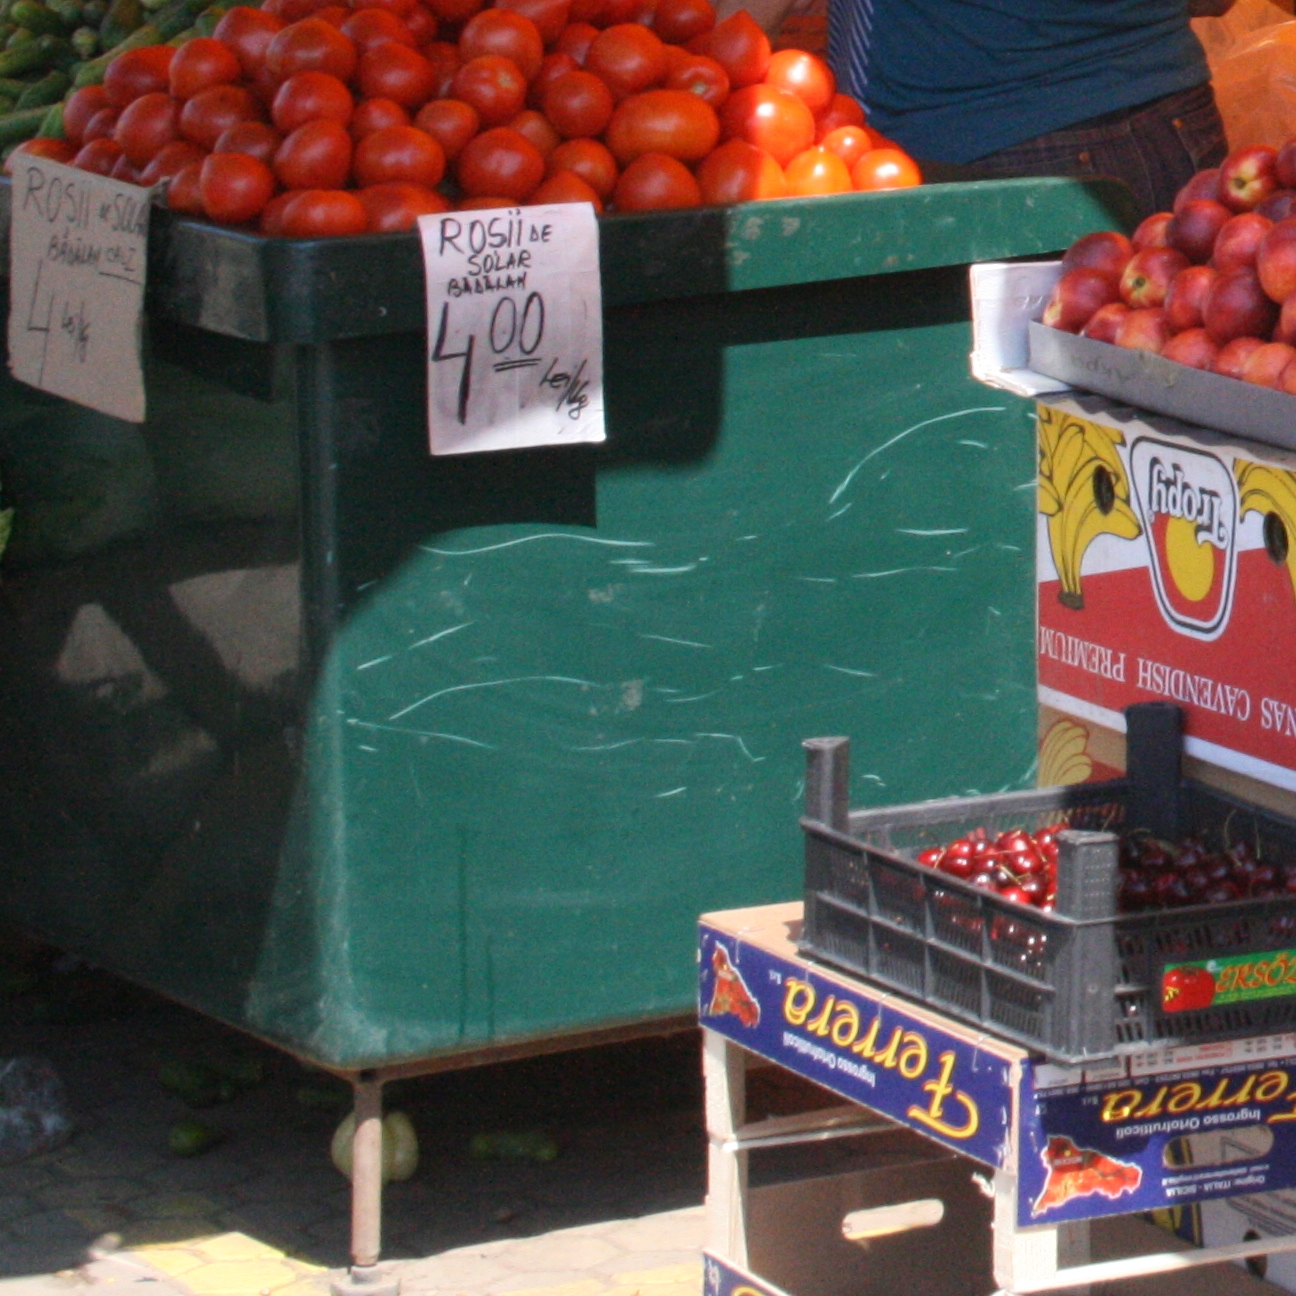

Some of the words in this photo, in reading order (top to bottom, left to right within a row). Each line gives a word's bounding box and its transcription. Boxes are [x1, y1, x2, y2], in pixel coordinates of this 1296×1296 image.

[439, 208, 522, 257] ROSII
[529, 224, 552, 244] DE
[467, 249, 532, 277] SOLAR
[431, 300, 476, 426] 4
[1148, 456, 1228, 548] Tropy
[1039, 626, 1127, 683] PREMIUM
[1136, 656, 1251, 721] CAVENDISH
[783, 977, 979, 1140] Ferrera
[836, 1056, 876, 1088] Ingrosso
[1115, 1116, 1201, 1139] Ortofrutticoli
[1202, 1107, 1261, 1125] Ingrosso
[1203, 1179, 1232, 1193] ITALIA
